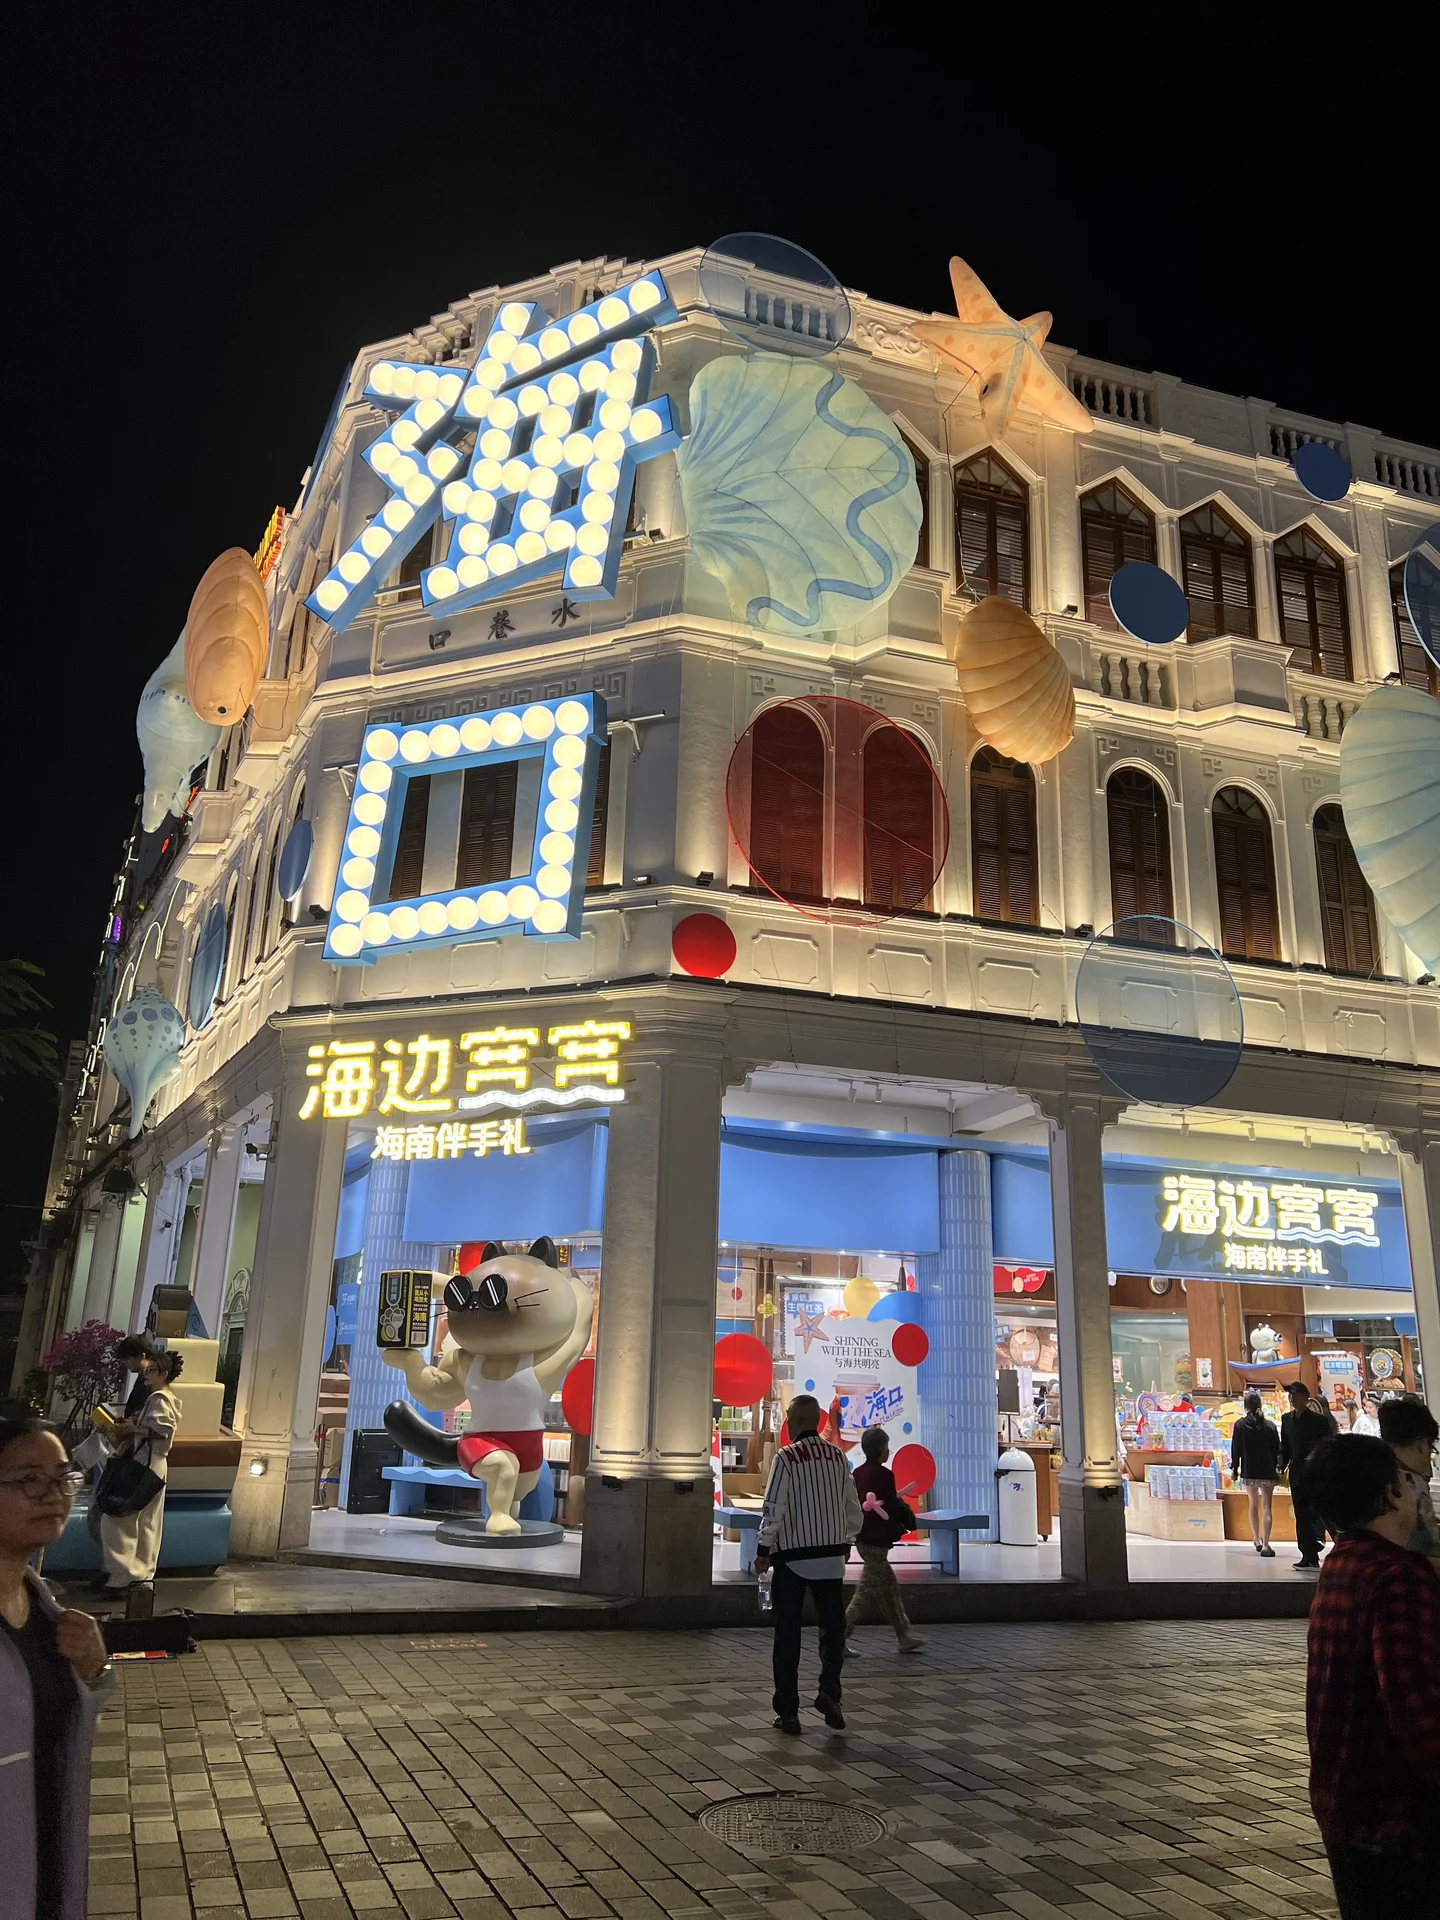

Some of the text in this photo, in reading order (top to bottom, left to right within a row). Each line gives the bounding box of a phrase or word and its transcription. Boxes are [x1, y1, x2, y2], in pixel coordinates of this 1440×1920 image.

[370, 1118, 534, 1161] 海南伴手礼
[1223, 1241, 1330, 1274] 海南伴手礼
[821, 1346, 892, 1358] WITH THE SEA
[834, 1336, 879, 1347] SHINING
[834, 1358, 880, 1369] 与海共明亮
[865, 1386, 903, 1419] 海口
[784, 1443, 844, 1465] AMOUR
